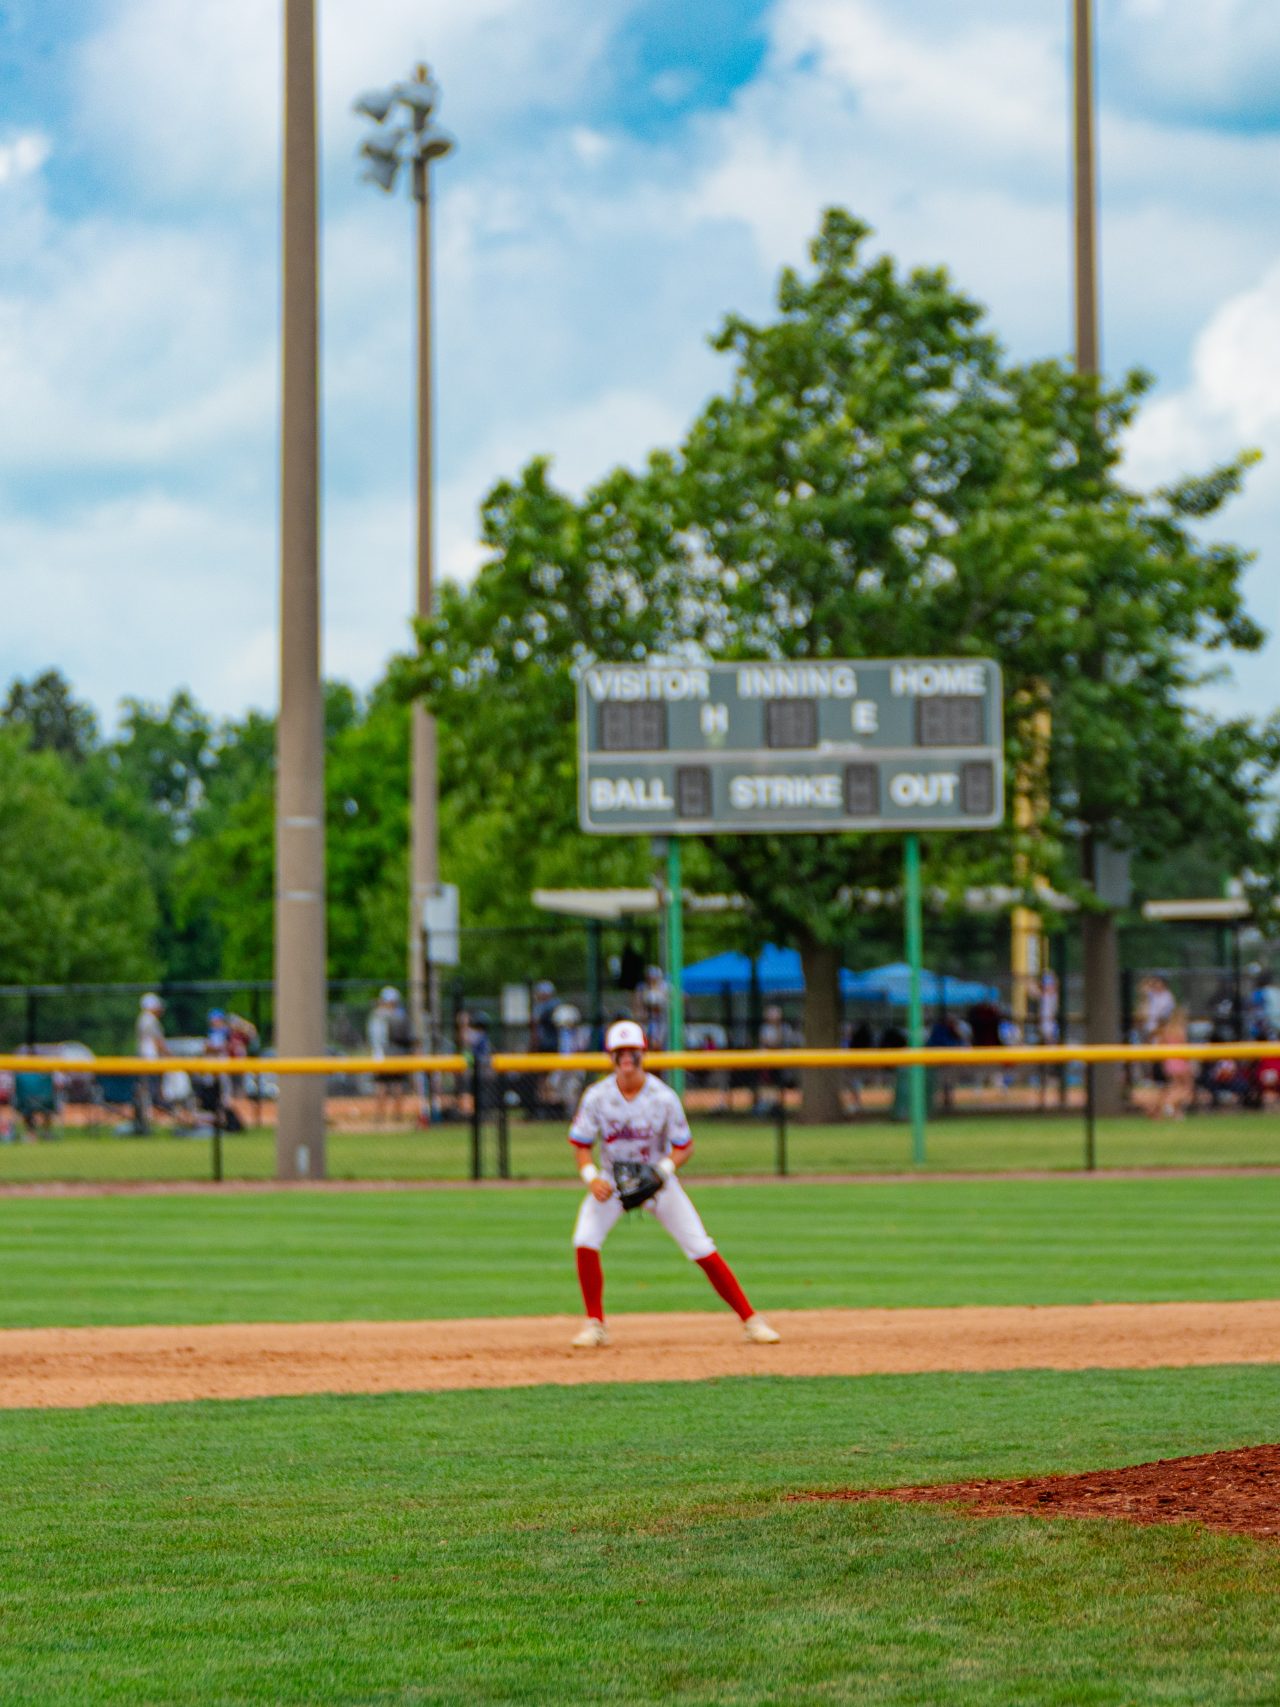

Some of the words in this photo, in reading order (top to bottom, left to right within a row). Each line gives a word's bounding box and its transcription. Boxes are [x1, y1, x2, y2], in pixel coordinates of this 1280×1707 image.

[585, 668, 710, 700] VISITOR
[736, 664, 858, 699] INNING
[889, 663, 988, 697] HOME
[700, 702, 729, 735] H
[851, 699, 879, 733] E
[590, 776, 674, 811] BALL
[729, 775, 843, 808] STRIKE
[890, 773, 960, 807] OUT
